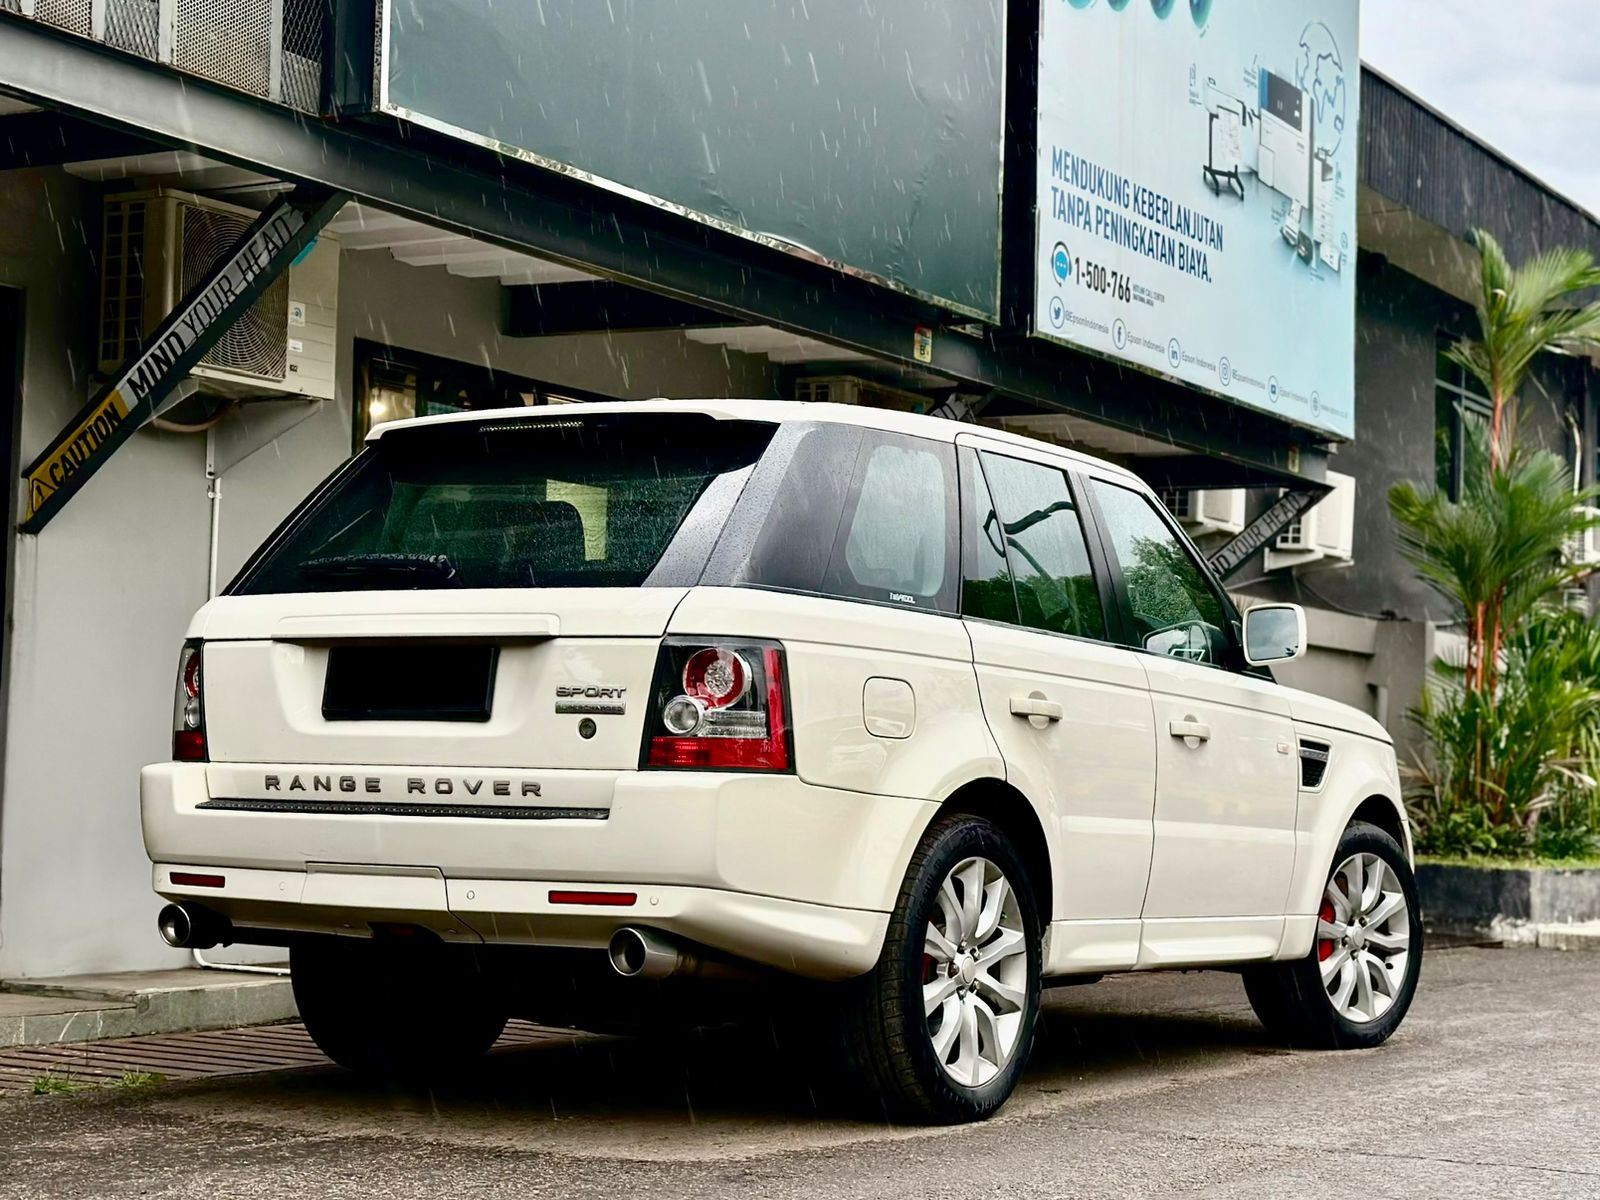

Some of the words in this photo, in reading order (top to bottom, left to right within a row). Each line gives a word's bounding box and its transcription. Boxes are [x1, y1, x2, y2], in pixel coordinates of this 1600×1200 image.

[1052, 145, 1130, 208] MENDUKUNG
[1133, 182, 1223, 252] KEBERLANJUTAN
[1051, 186, 1092, 233] TANPA
[1095, 206, 1175, 267] PENINGKATAN
[1178, 242, 1212, 282] BIAYA.
[1074, 256, 1131, 303] 1-500-766
[1065, 310, 1109, 334] @EpsonIndonesia
[1127, 331, 1141, 347] Epson
[1142, 337, 1165, 354] Indonesia
[49, 401, 121, 489] CAUTION
[126, 330, 186, 398] MIND
[181, 273, 239, 338] YOUR
[236, 214, 296, 284] HEAD
[1211, 553, 1231, 576] ND
[1227, 525, 1267, 560] YOUR
[1263, 494, 1301, 533] HEAD
[556, 686, 627, 699] SPORT
[265, 774, 382, 794] RANGE
[408, 777, 542, 798] ROVER
